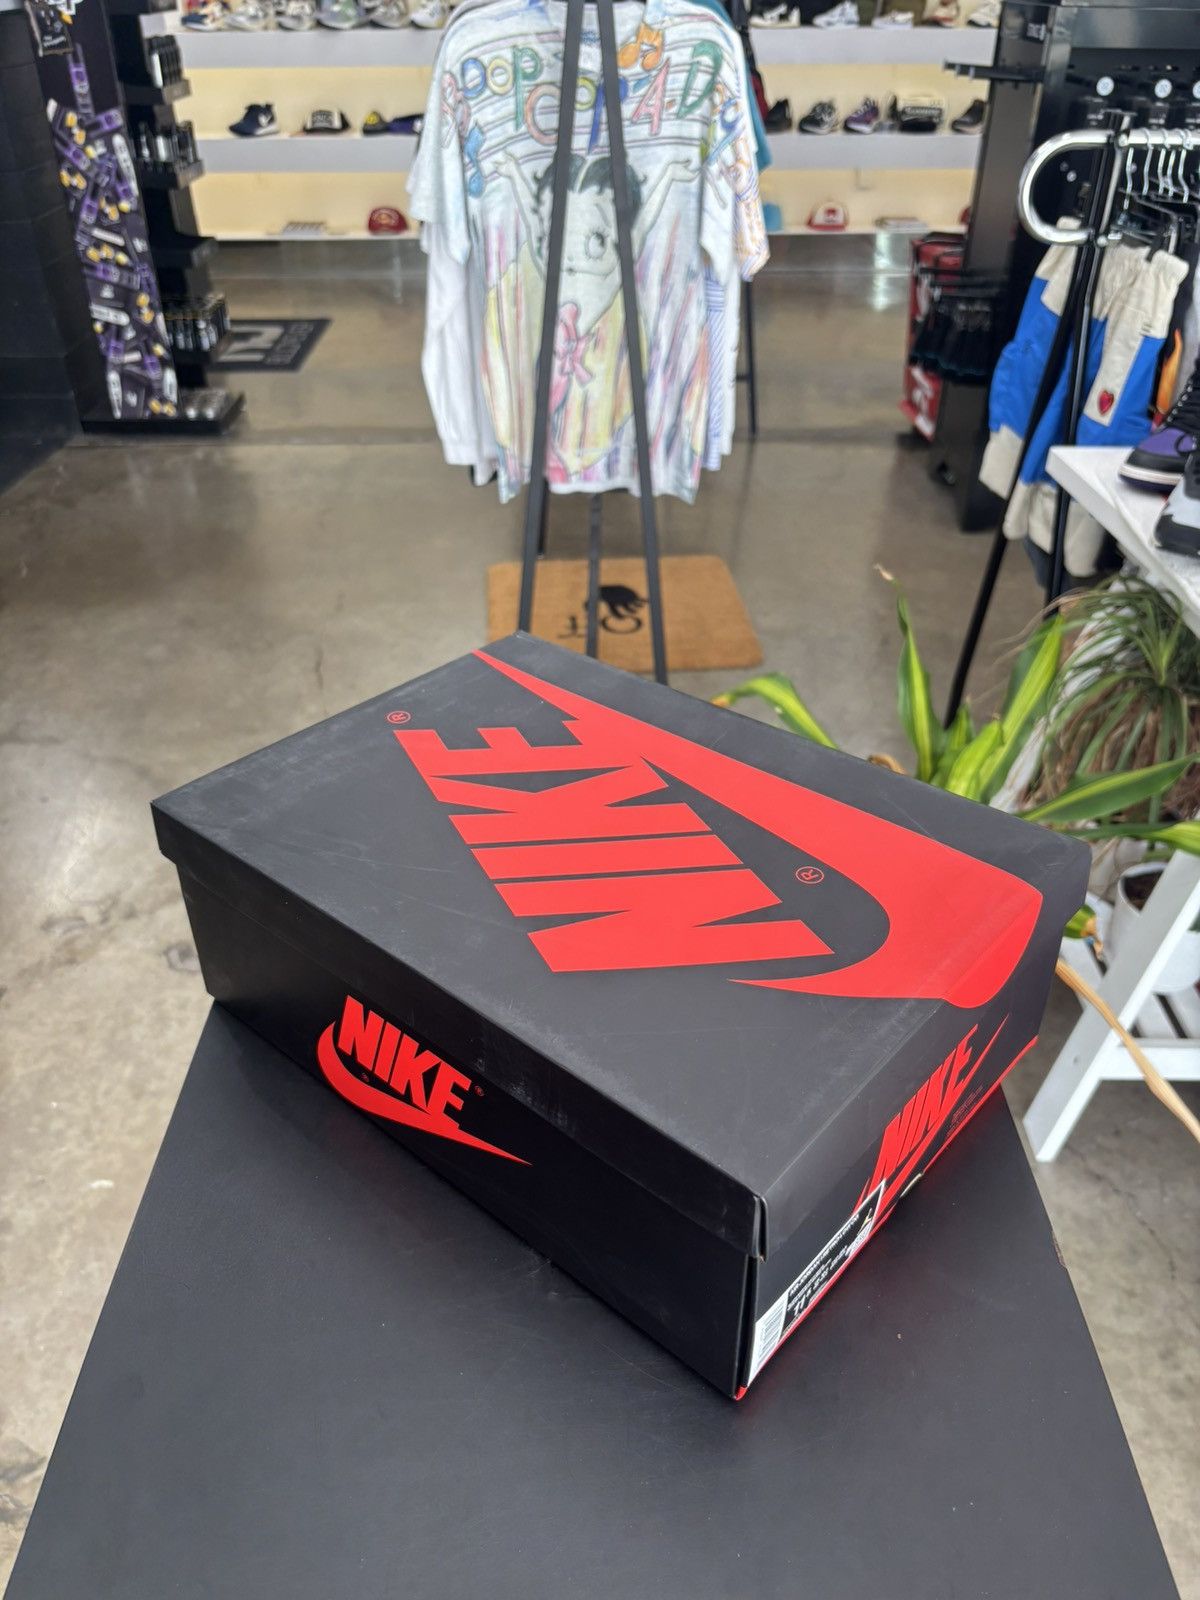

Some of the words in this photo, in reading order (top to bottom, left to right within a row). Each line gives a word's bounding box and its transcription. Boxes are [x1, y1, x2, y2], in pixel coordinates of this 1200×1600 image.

[393, 720, 835, 973] NIKE
[338, 994, 472, 1129] NIKE
[867, 1023, 978, 1196] NIKE
